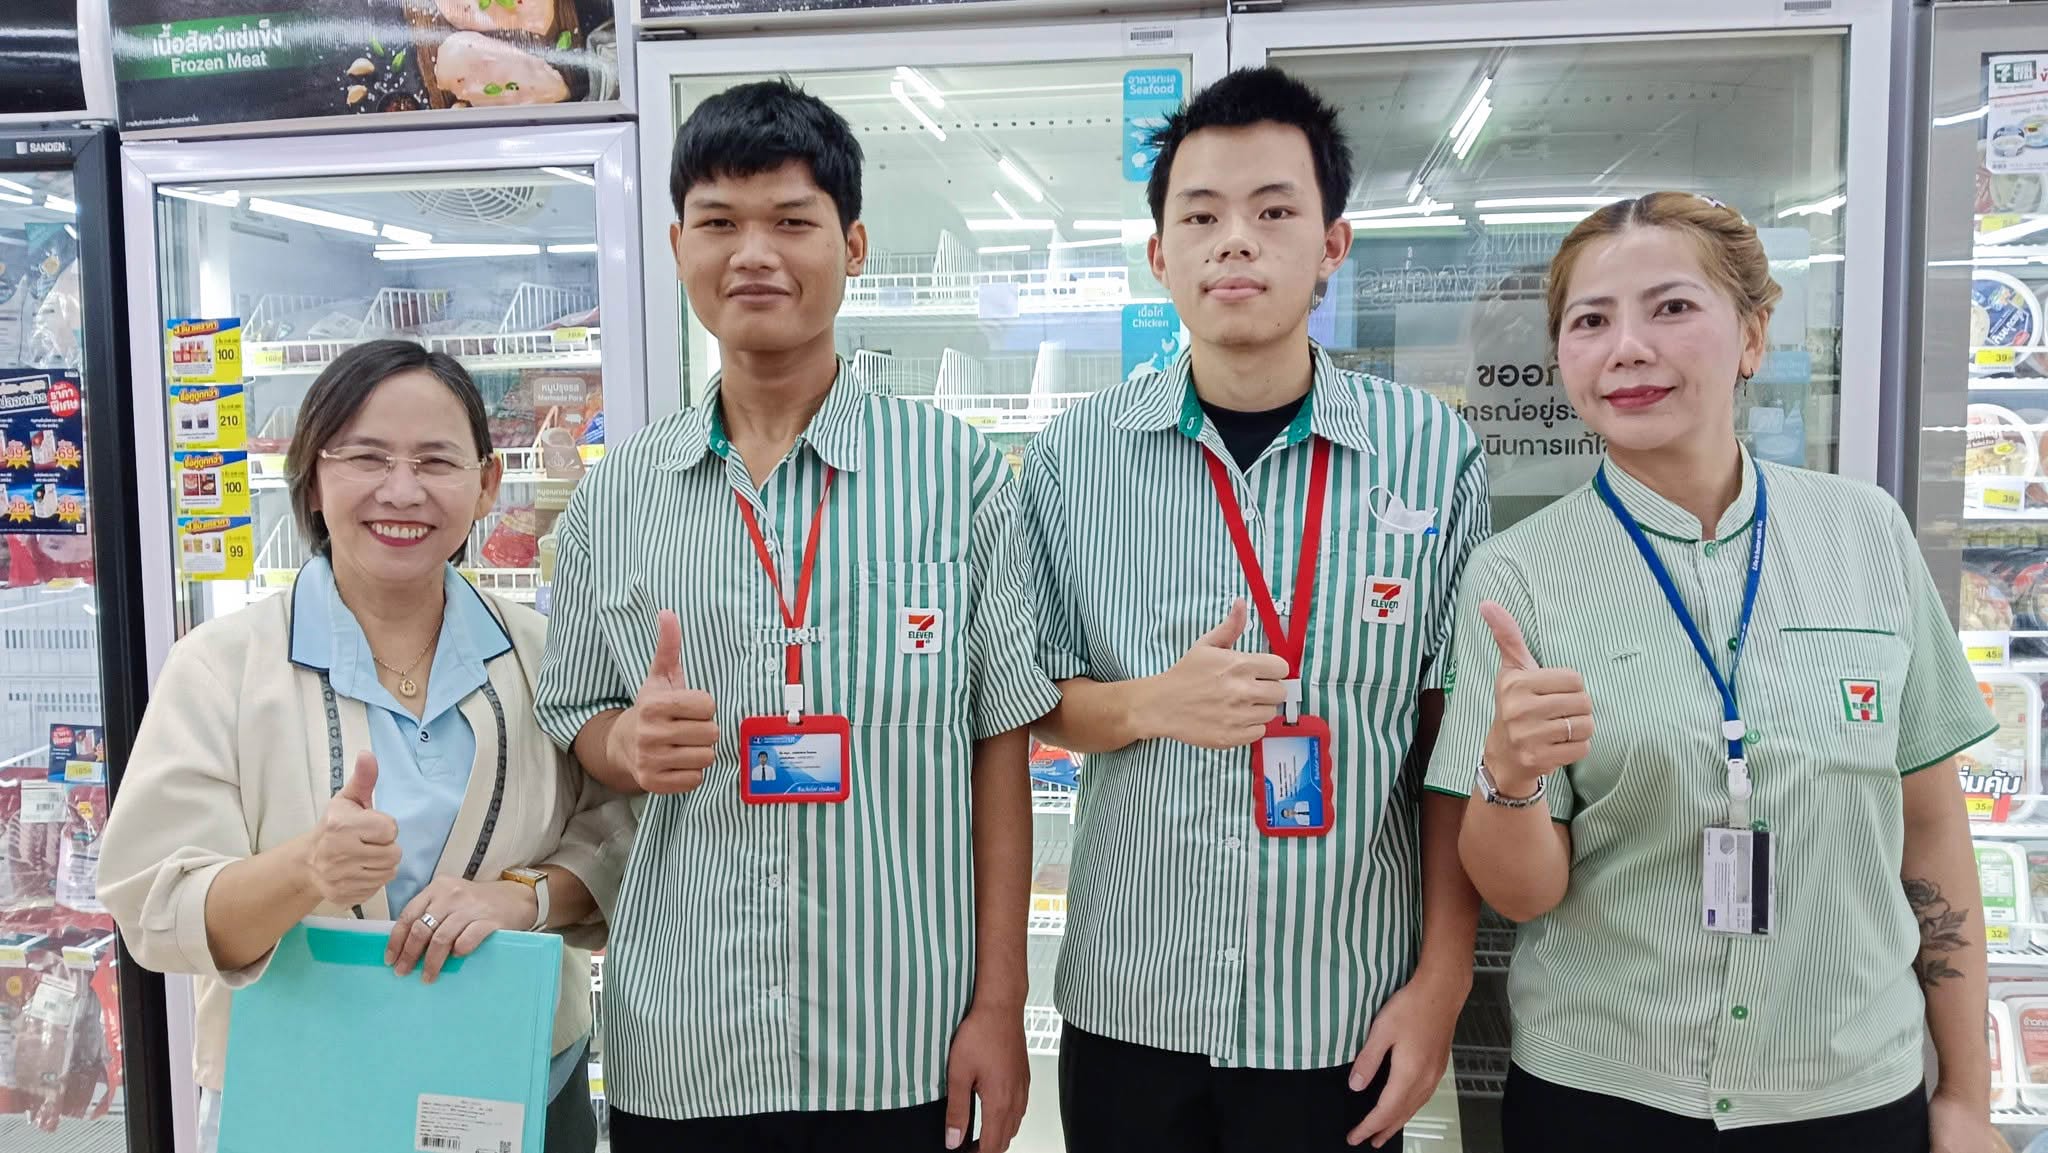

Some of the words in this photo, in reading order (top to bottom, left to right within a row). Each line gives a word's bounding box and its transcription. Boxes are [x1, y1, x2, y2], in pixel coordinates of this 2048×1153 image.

[153, 19, 282, 56] เนื้อสัตว์แช่แข็ง
[171, 57, 224, 74] Frozen
[227, 51, 268, 69] Meat
[1128, 75, 1176, 84] อาหารทะเล
[1129, 84, 1175, 95] Seafood
[30, 142, 65, 152] SANDEN
[1137, 305, 1164, 318] เนื้อไก่
[1132, 318, 1169, 328] Chicken
[217, 349, 234, 360] 100
[220, 416, 238, 426] 210
[225, 482, 241, 493] 100
[229, 545, 244, 557] 99
